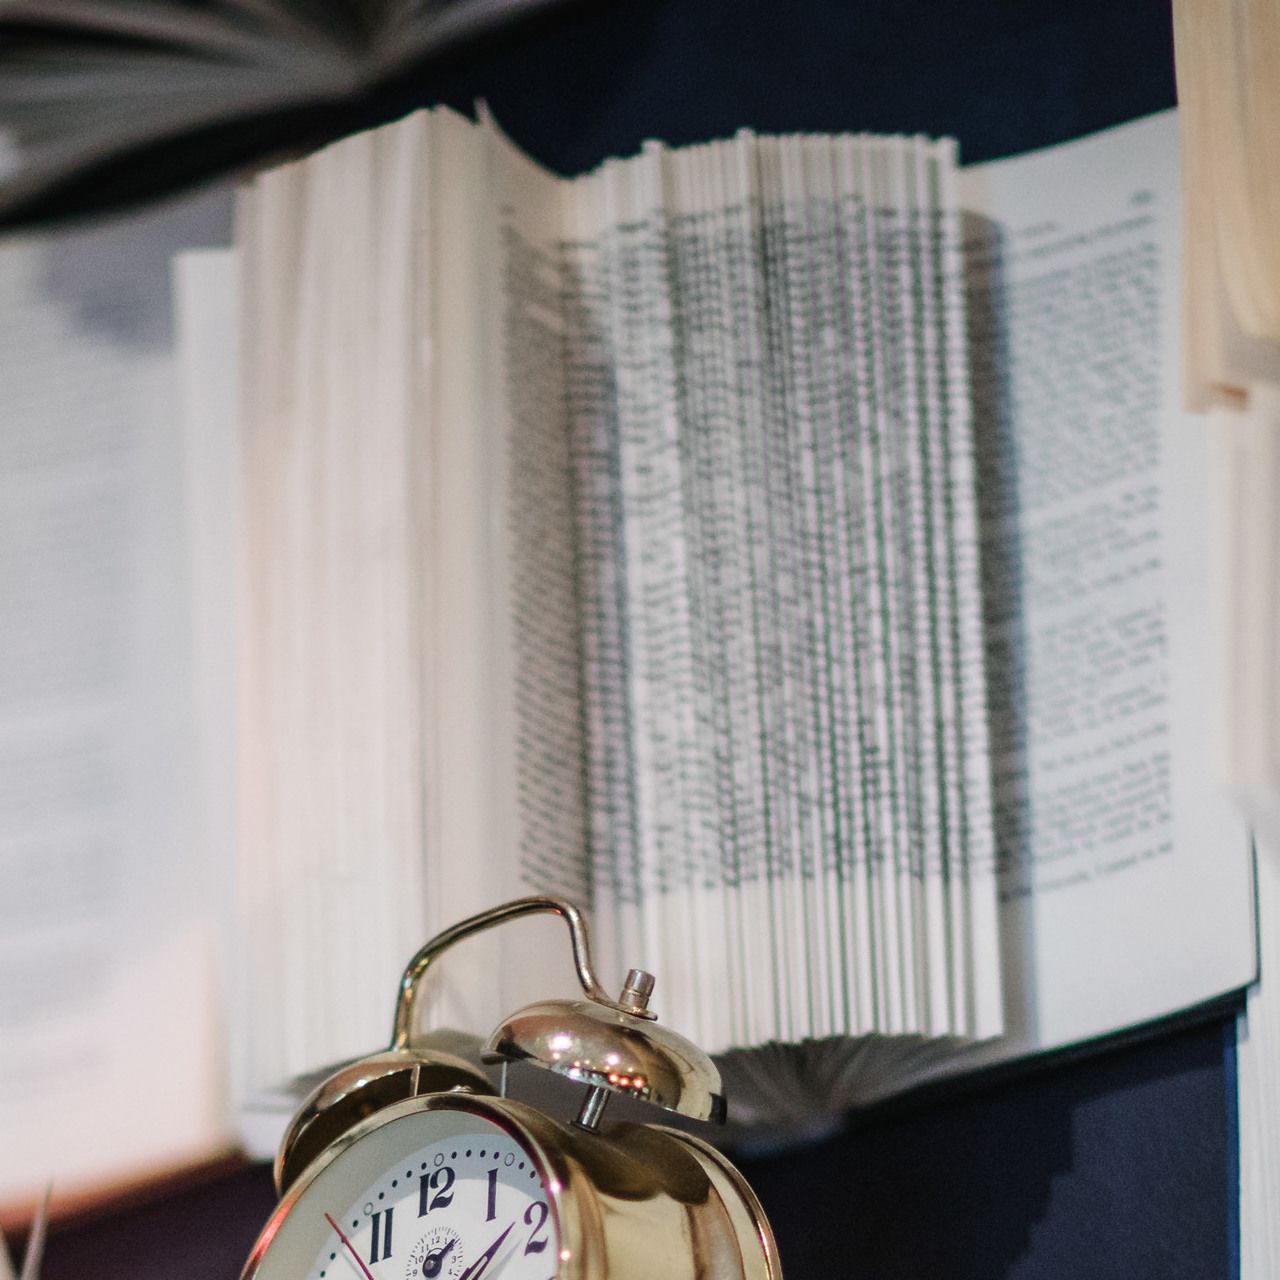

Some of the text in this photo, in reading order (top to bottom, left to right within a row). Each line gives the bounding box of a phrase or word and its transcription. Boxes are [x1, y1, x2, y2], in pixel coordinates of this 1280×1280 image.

[369, 1166, 498, 1265] 11 12 1
[523, 1201, 549, 1257] 2
[431, 1235, 440, 1246] 12
[415, 1255, 424, 1265] 10
